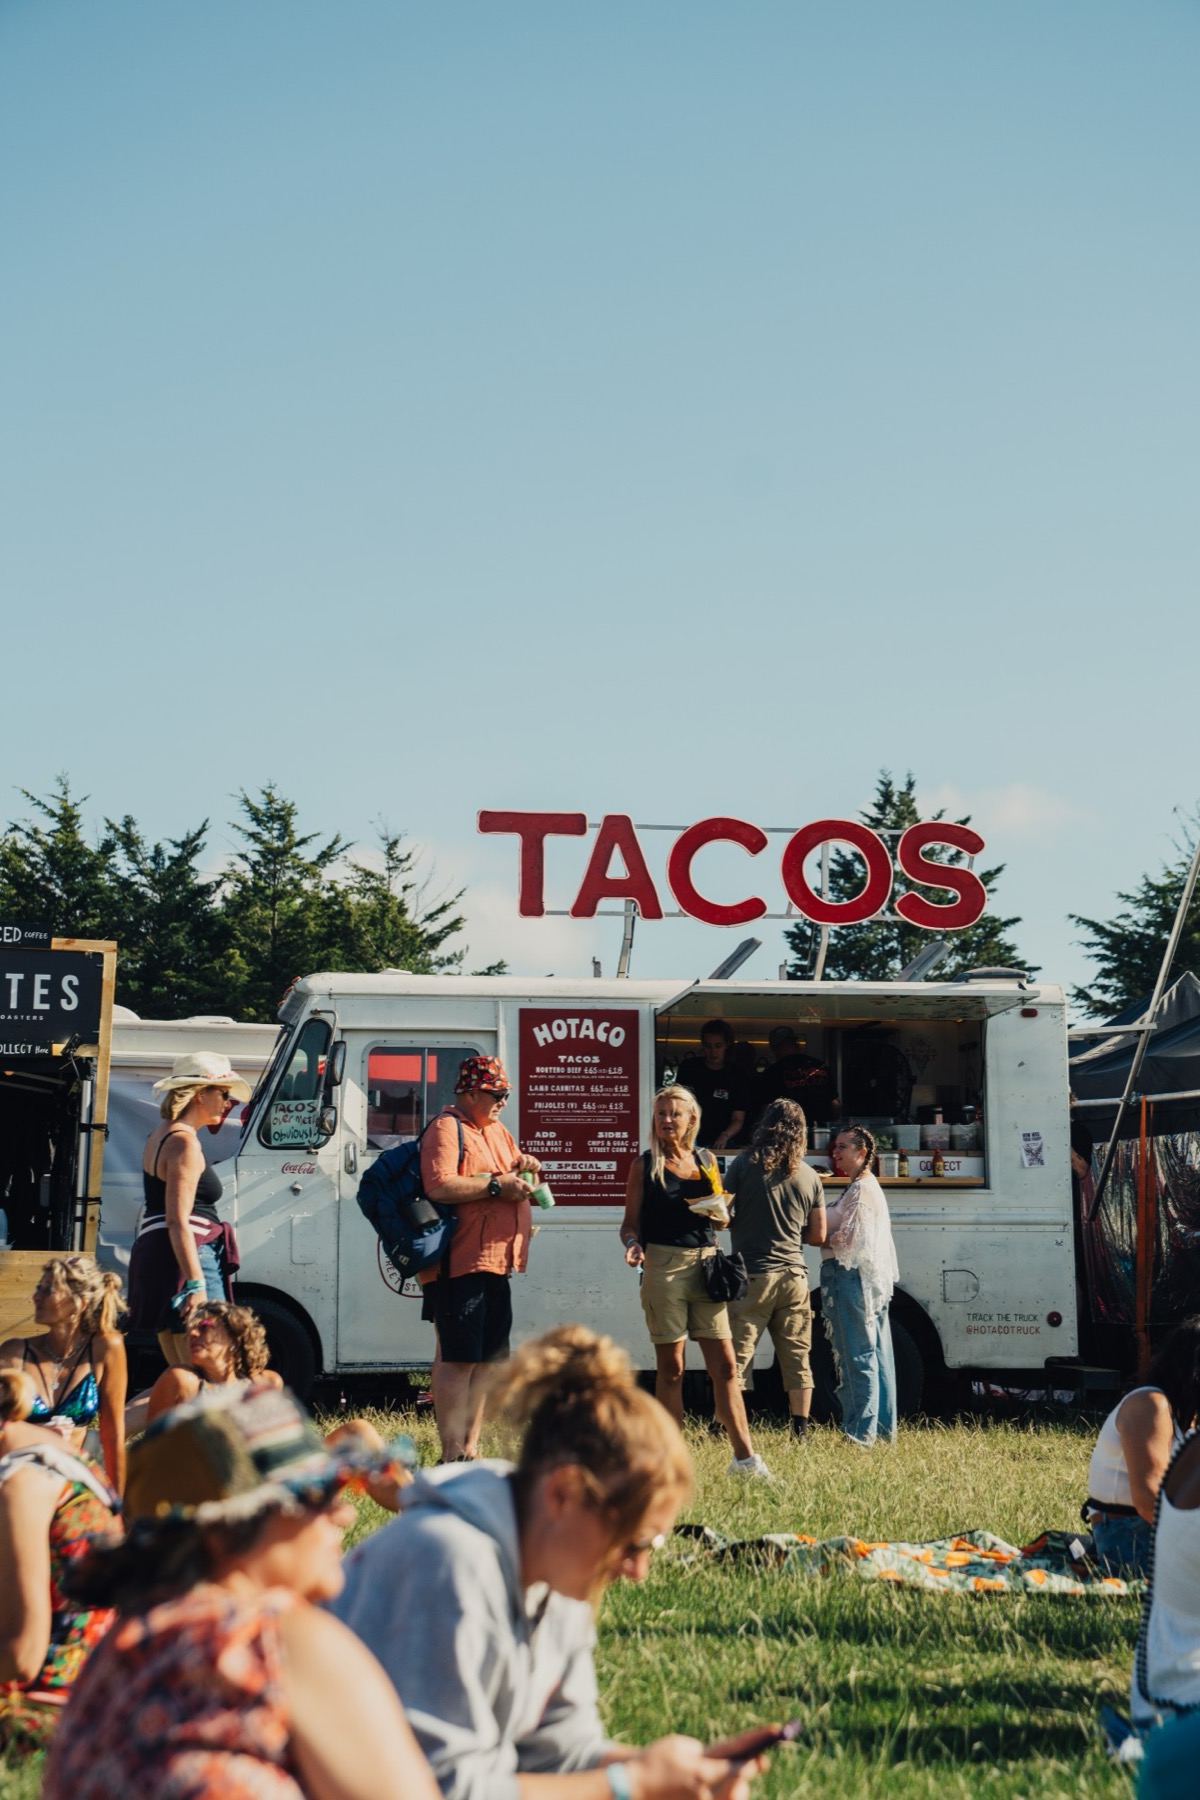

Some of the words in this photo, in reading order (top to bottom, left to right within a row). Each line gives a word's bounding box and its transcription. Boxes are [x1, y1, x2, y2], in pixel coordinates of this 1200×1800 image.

[476, 808, 988, 930] TACOS
[0, 926, 22, 942] ED
[24, 931, 48, 940] COFFEE
[5, 973, 80, 1011] TES
[532, 1018, 626, 1048] HOTACO
[558, 1055, 601, 1063] TACOS
[566, 1066, 582, 1074] BEEF
[273, 1102, 317, 1114] TACOS
[920, 1161, 961, 1171] COECT
[967, 1313, 994, 1322] TRACK
[996, 1313, 1011, 1322] THE
[1014, 1313, 1039, 1322] TRUCK
[966, 1325, 1041, 1335] @HOTACOTRUCK
